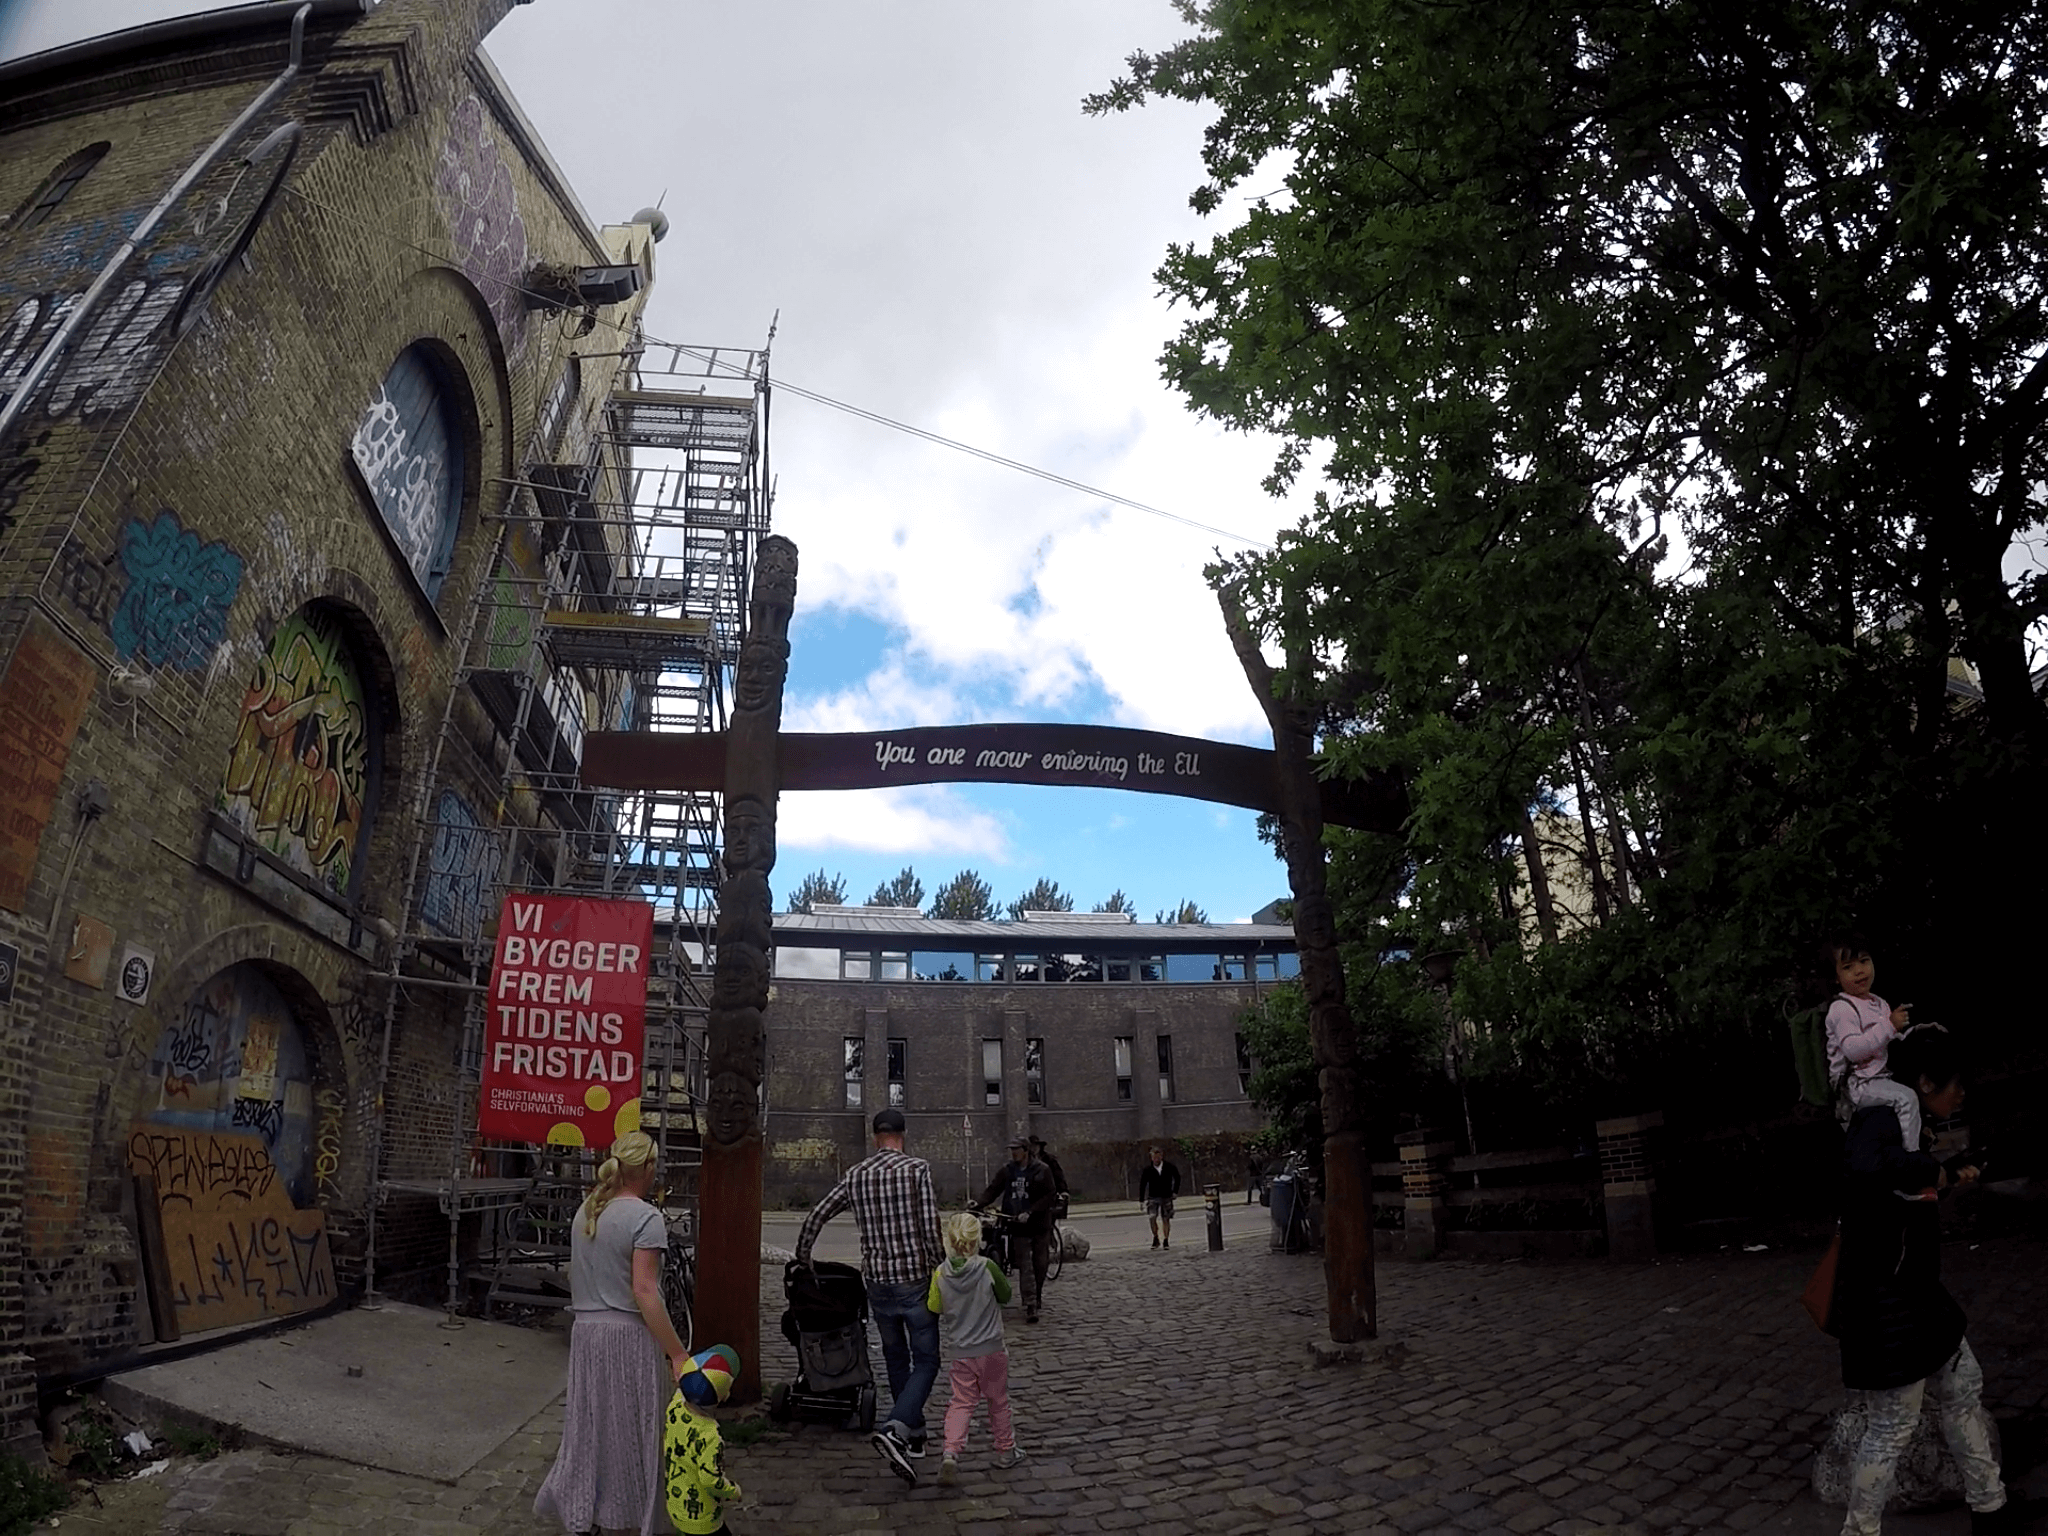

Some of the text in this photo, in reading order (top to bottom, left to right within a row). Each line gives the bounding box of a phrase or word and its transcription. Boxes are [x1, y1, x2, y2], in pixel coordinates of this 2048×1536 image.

[875, 740, 1201, 782] You are now entering the EU
[512, 901, 544, 934] VI
[503, 935, 641, 974] BYGGER
[497, 969, 594, 1006] FREM
[496, 1005, 624, 1045] TIDENS
[493, 1042, 635, 1083] FRISTAD
[490, 1099, 585, 1117] SELVFORVALTNING
[491, 1087, 565, 1105] CHRISTIANIA'S
